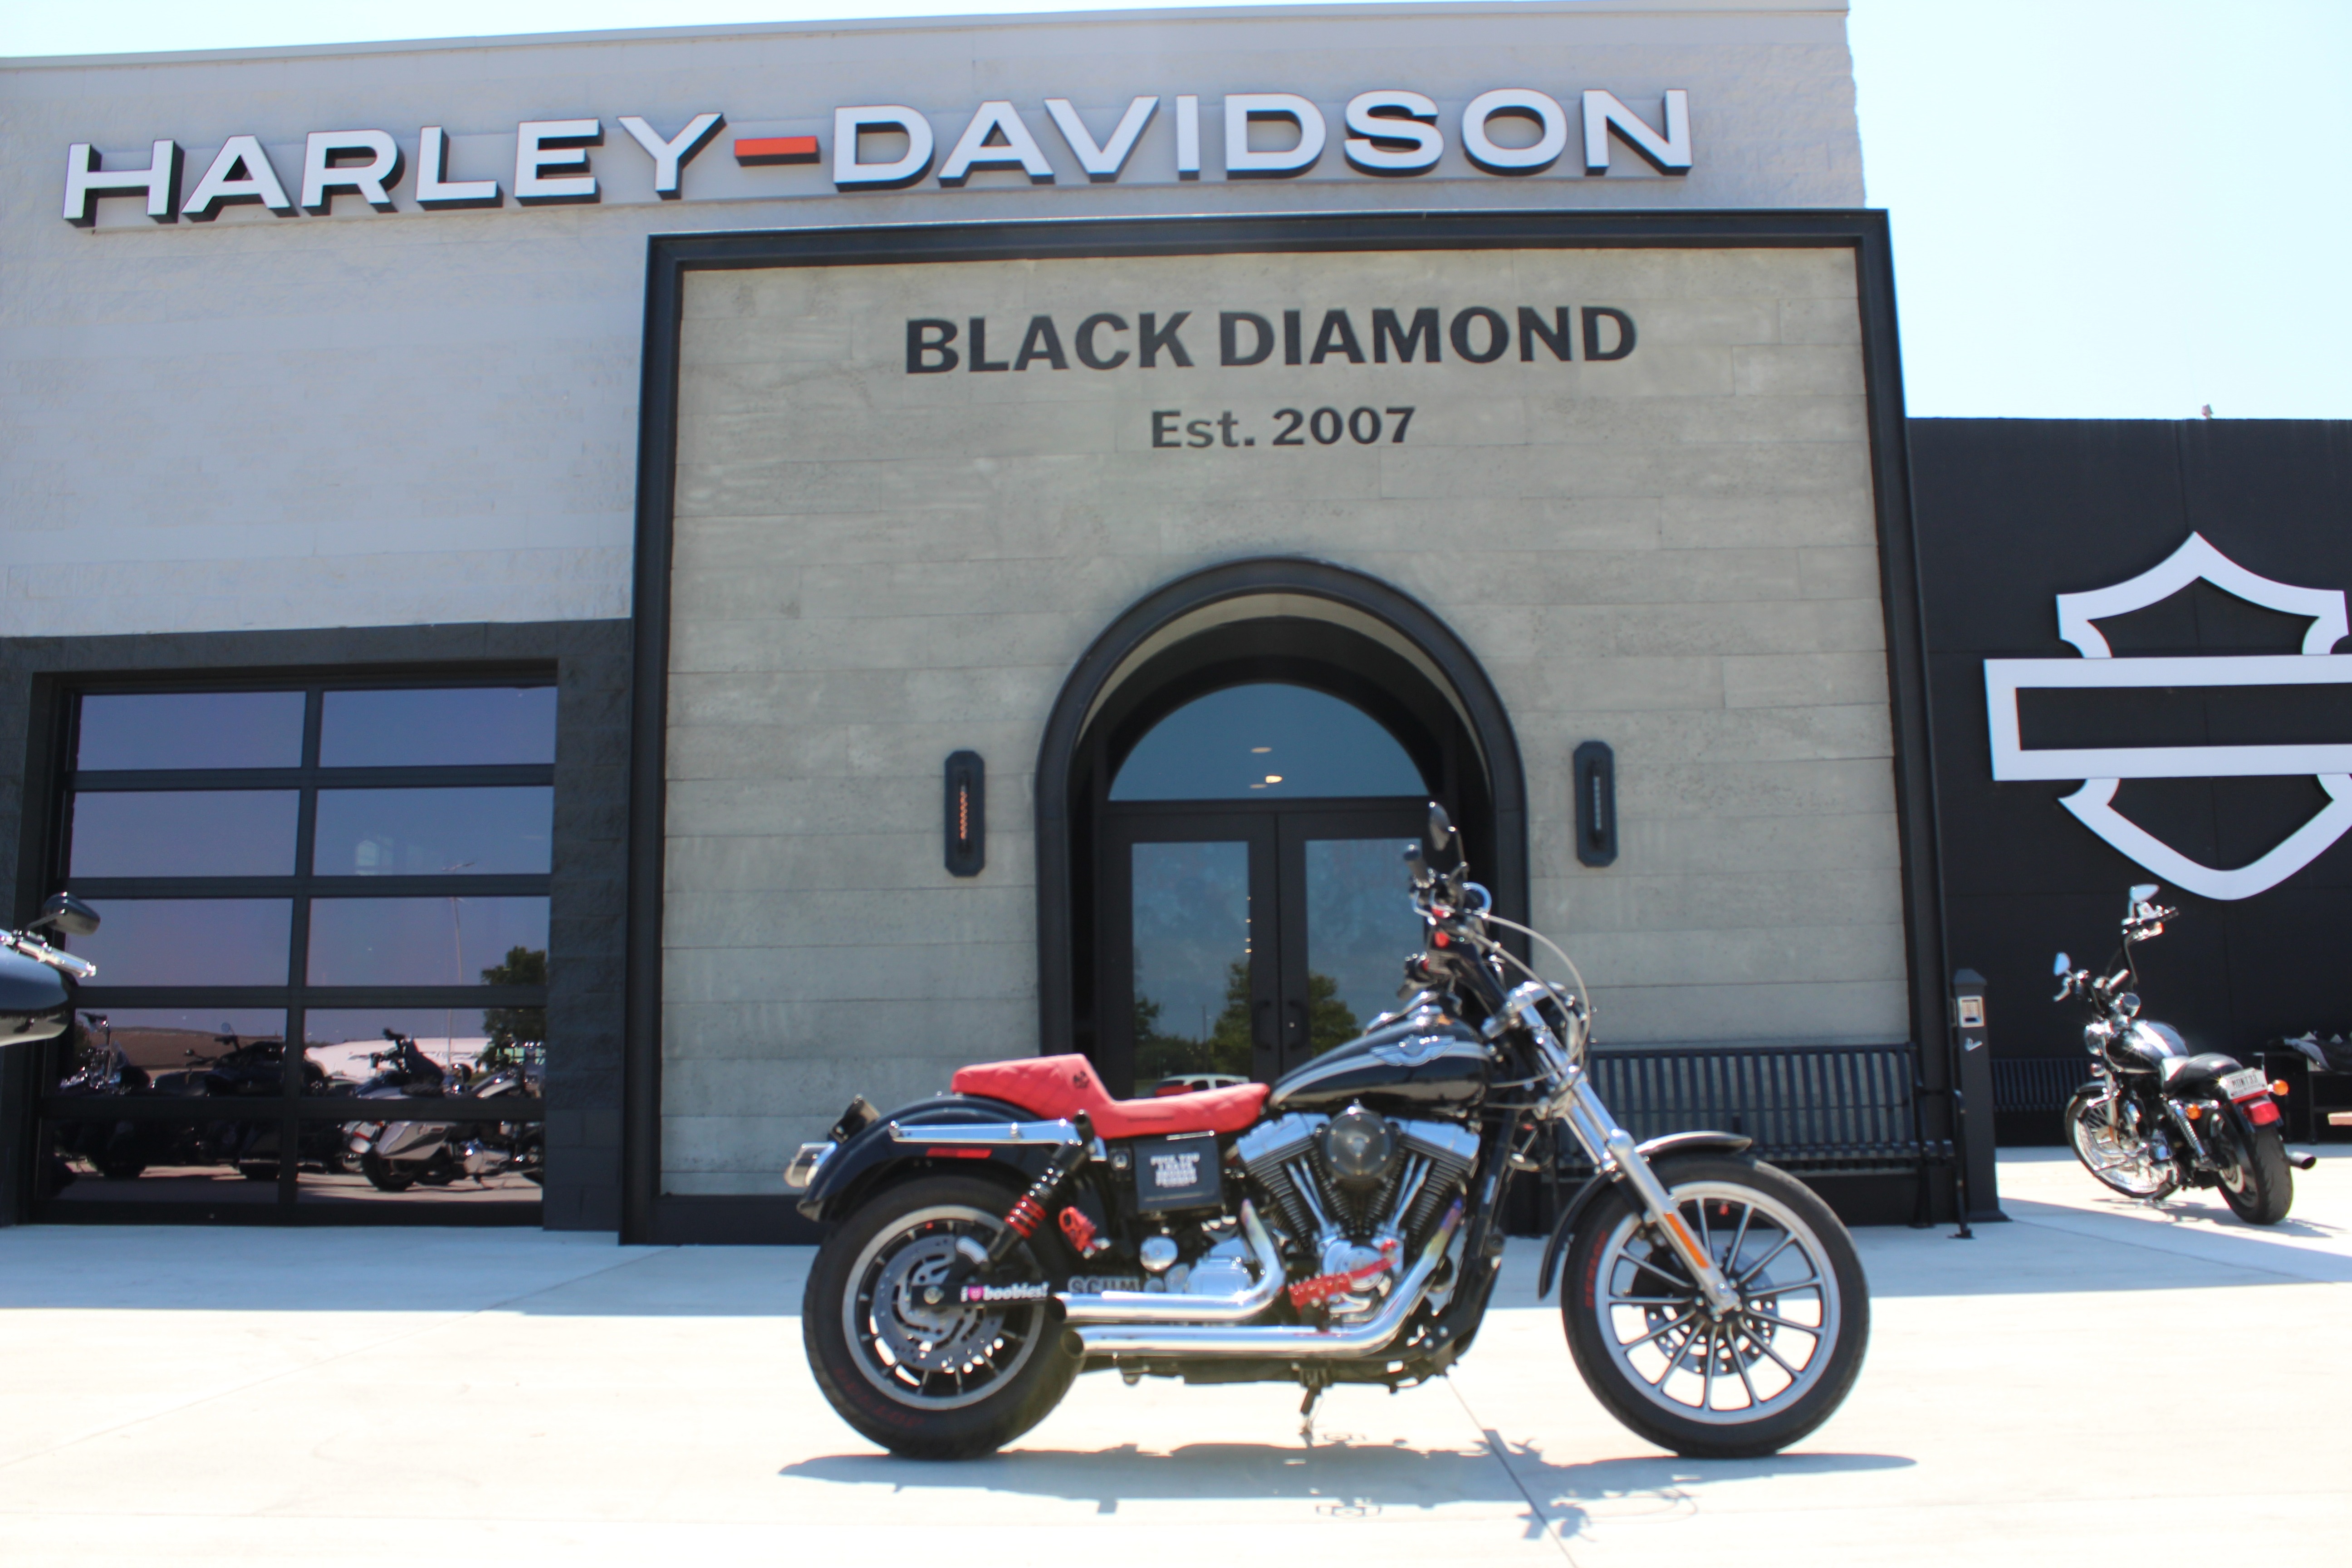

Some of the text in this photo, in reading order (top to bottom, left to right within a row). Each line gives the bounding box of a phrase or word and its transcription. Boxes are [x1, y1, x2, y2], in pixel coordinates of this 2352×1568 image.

[906, 307, 1636, 373] BLACK DIAMOND
[1153, 407, 1414, 448] Est. 2007
[983, 1282, 1050, 1301] boobies!
